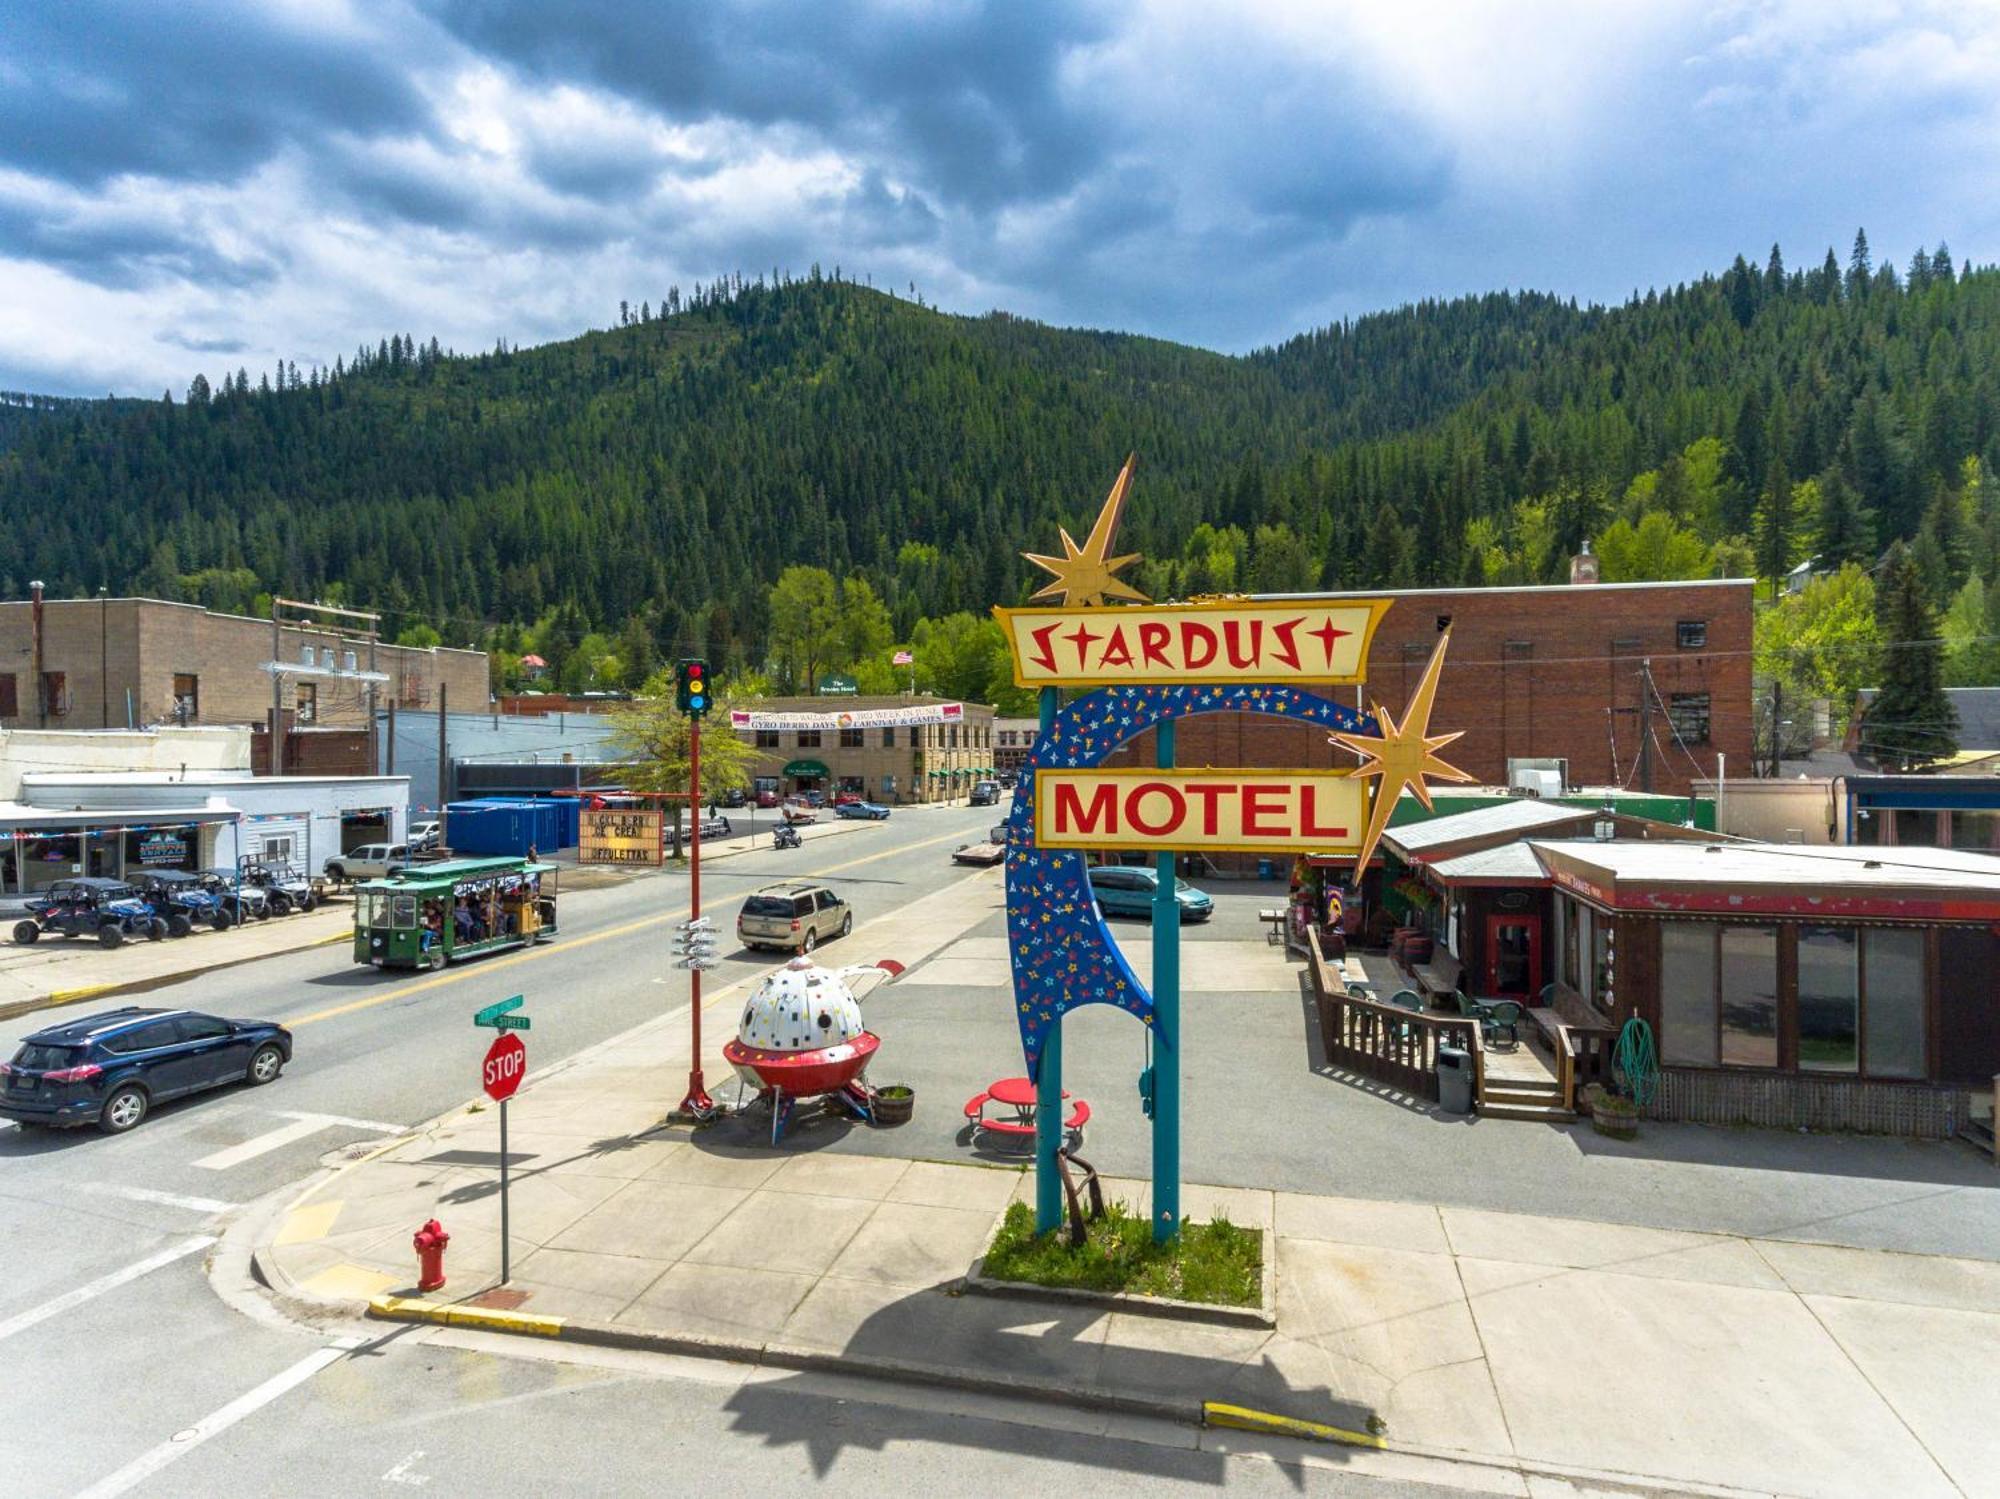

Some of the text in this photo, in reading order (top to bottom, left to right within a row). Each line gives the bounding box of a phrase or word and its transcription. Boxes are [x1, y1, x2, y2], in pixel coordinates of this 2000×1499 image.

[1028, 614, 1353, 674] STARDUST
[752, 721, 836, 729] GYRO DERBY DAYS
[853, 718, 897, 728] CARNIVAL
[910, 715, 942, 724] GAMES
[1055, 782, 1348, 838] MOTEL
[486, 1049, 523, 1085] STOP
